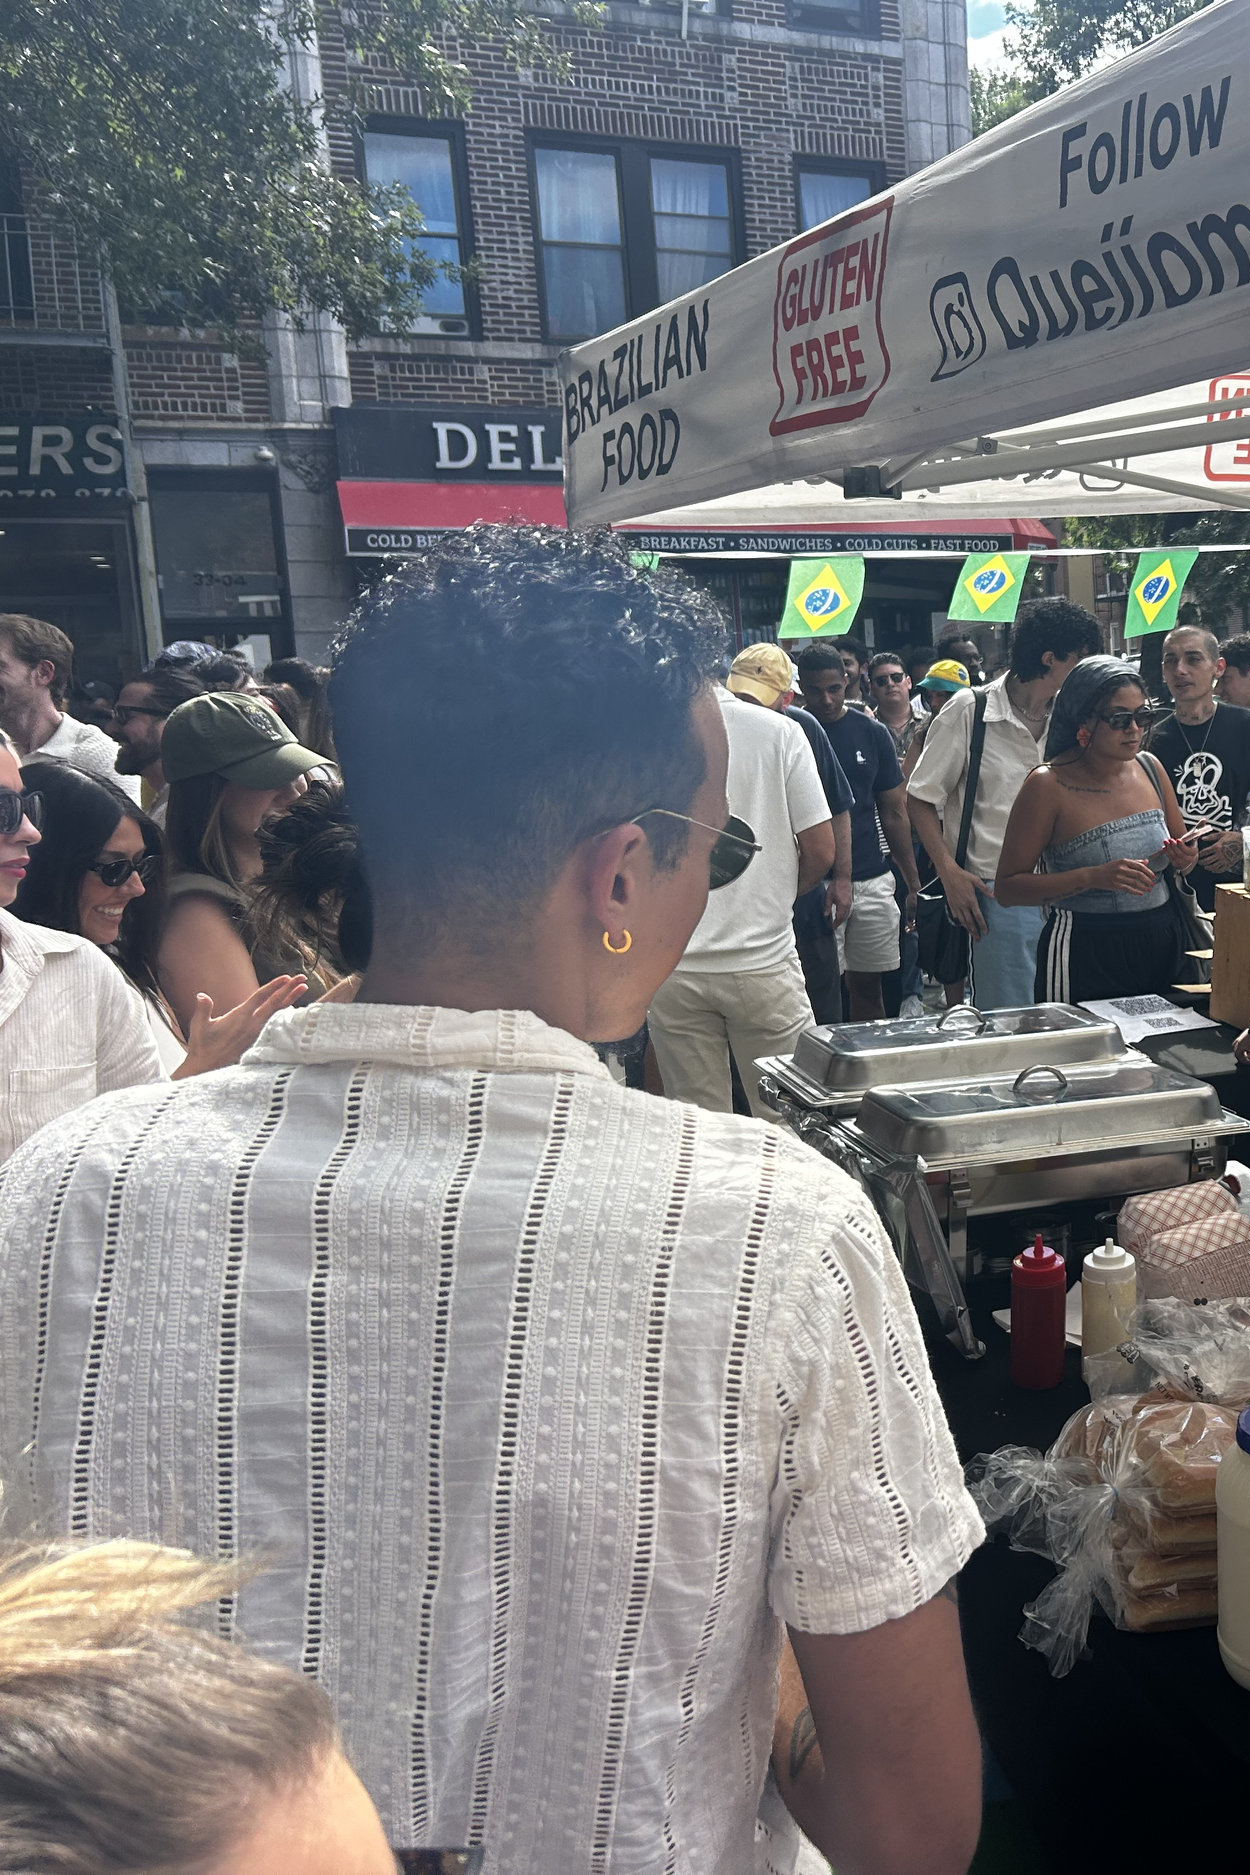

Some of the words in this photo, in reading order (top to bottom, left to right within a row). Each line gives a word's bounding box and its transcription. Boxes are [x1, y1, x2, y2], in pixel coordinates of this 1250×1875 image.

[1058, 75, 1232, 209] Follow
[780, 231, 880, 332] GLUTEN
[565, 298, 710, 447] BRAZILIAN
[791, 325, 867, 405] FREE
[601, 408, 681, 492] FOOD
[367, 534, 412, 547] COLD
[640, 537, 726, 549] BREAKFAST
[739, 538, 832, 550] SANDWICHES
[846, 538, 881, 550] COLD
[885, 539, 919, 551] CUTS
[931, 540, 962, 551] FAST
[965, 540, 999, 551] FOOD
